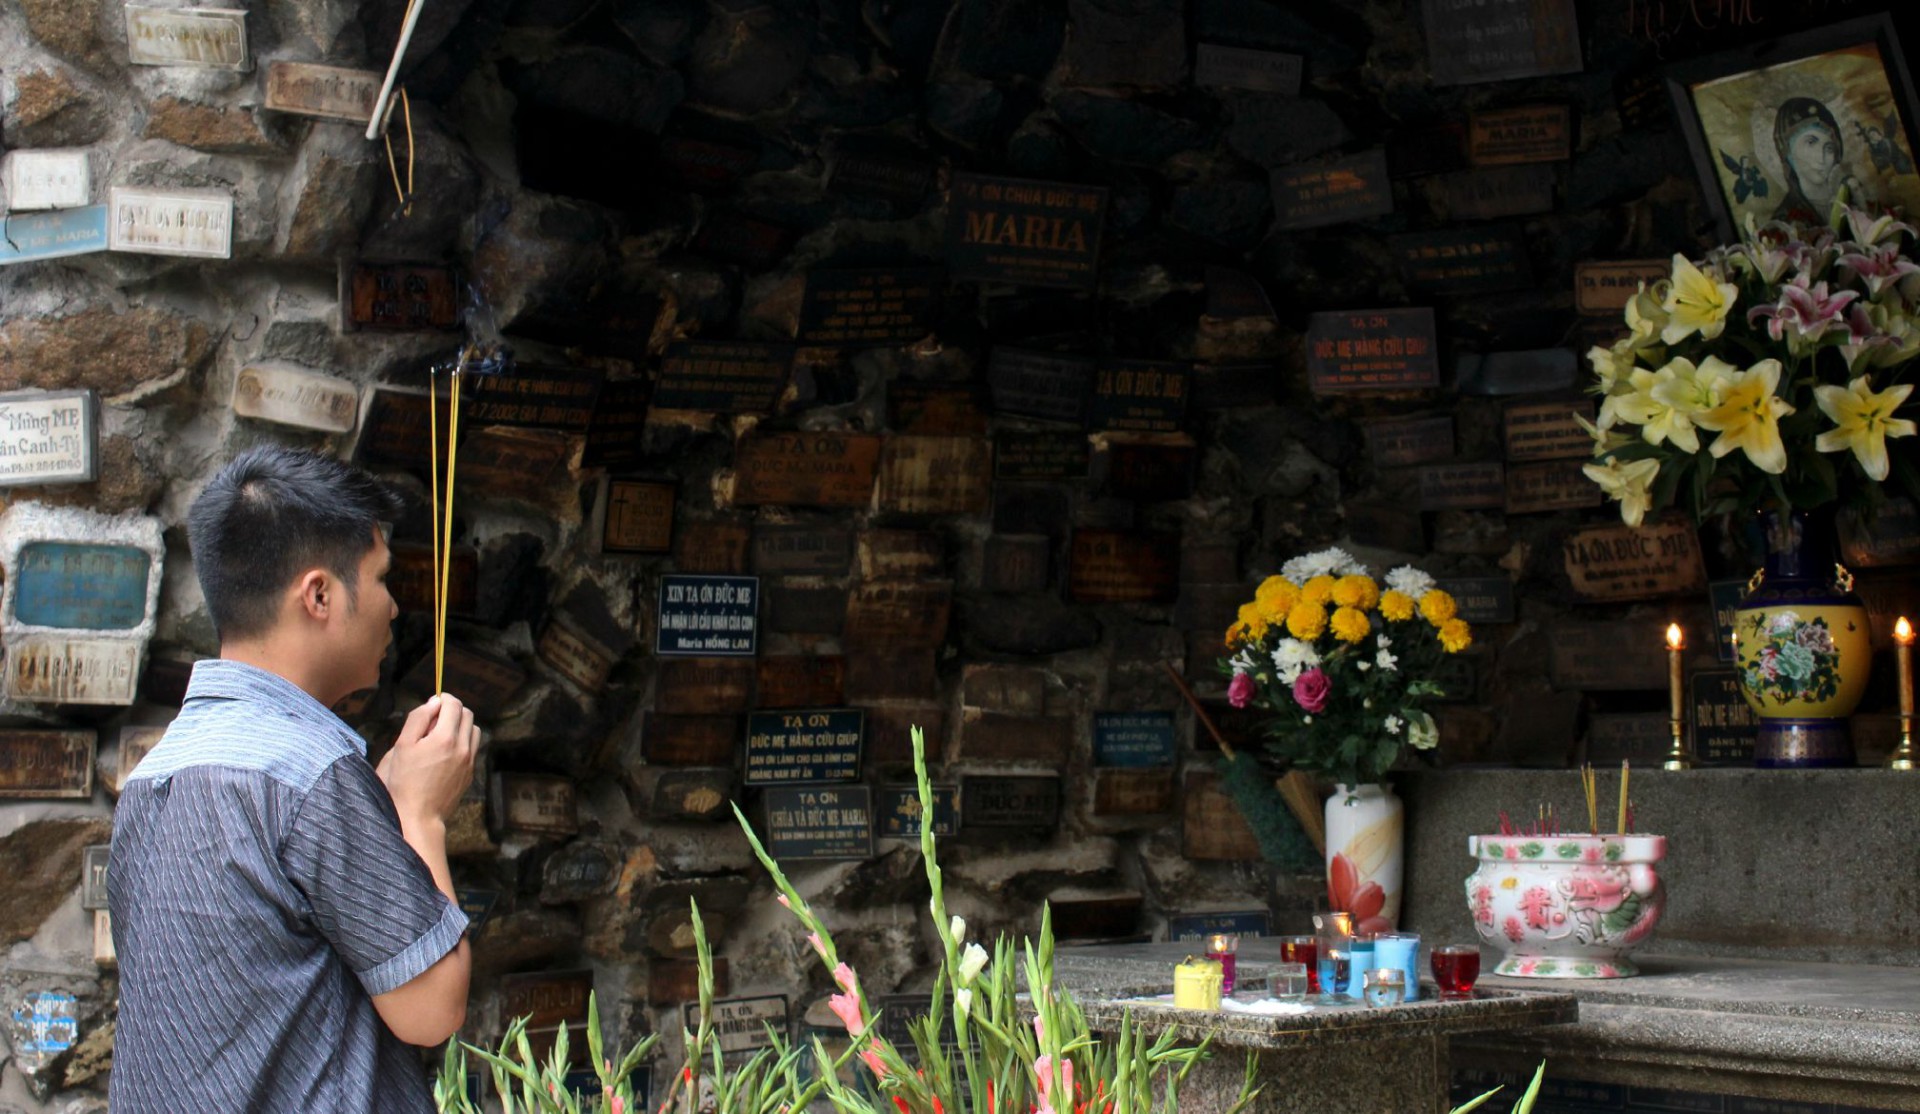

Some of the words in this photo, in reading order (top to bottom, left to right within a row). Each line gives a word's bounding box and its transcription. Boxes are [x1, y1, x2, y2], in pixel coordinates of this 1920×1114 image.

[56, 229, 101, 247] MARIA
[962, 210, 1088, 252] MARIA
[1370, 315, 1388, 328] ƠN
[1336, 338, 1352, 358] MẸ
[9, 412, 50, 435] Mừng
[52, 407, 80, 431] MẸ
[814, 436, 848, 456] ƠN
[1590, 536, 1615, 562] ƠN
[1615, 530, 1654, 562] ĐỨC
[1656, 532, 1691, 560] MẸ
[666, 585, 685, 603] XIN
[686, 585, 699, 607] TẠ
[700, 583, 714, 604] ƠN
[715, 581, 736, 604] ĐỨC
[736, 586, 752, 608] MẸ
[741, 615, 754, 631] CON
[677, 637, 703, 649] Maria
[731, 638, 750, 650] LAN
[783, 714, 804, 729] TẠ
[808, 712, 831, 728] ƠN
[750, 732, 771, 749] ĐỨC
[771, 733, 787, 750] MẸ
[815, 730, 836, 747] CỨU
[836, 730, 859, 746] GIÚP
[796, 753, 811, 765] CHO
[812, 753, 824, 764] GIA
[842, 752, 857, 764] CON
[798, 793, 816, 807] TẠ
[819, 791, 839, 805] ƠN
[770, 807, 794, 828] CHÚA
[794, 806, 807, 827] VÀ
[807, 806, 826, 827] ĐỨC
[826, 809, 840, 829] MẸ
[840, 808, 868, 826] MARIA
[720, 1008, 734, 1020] TẠ
[738, 1003, 753, 1016] ƠN
